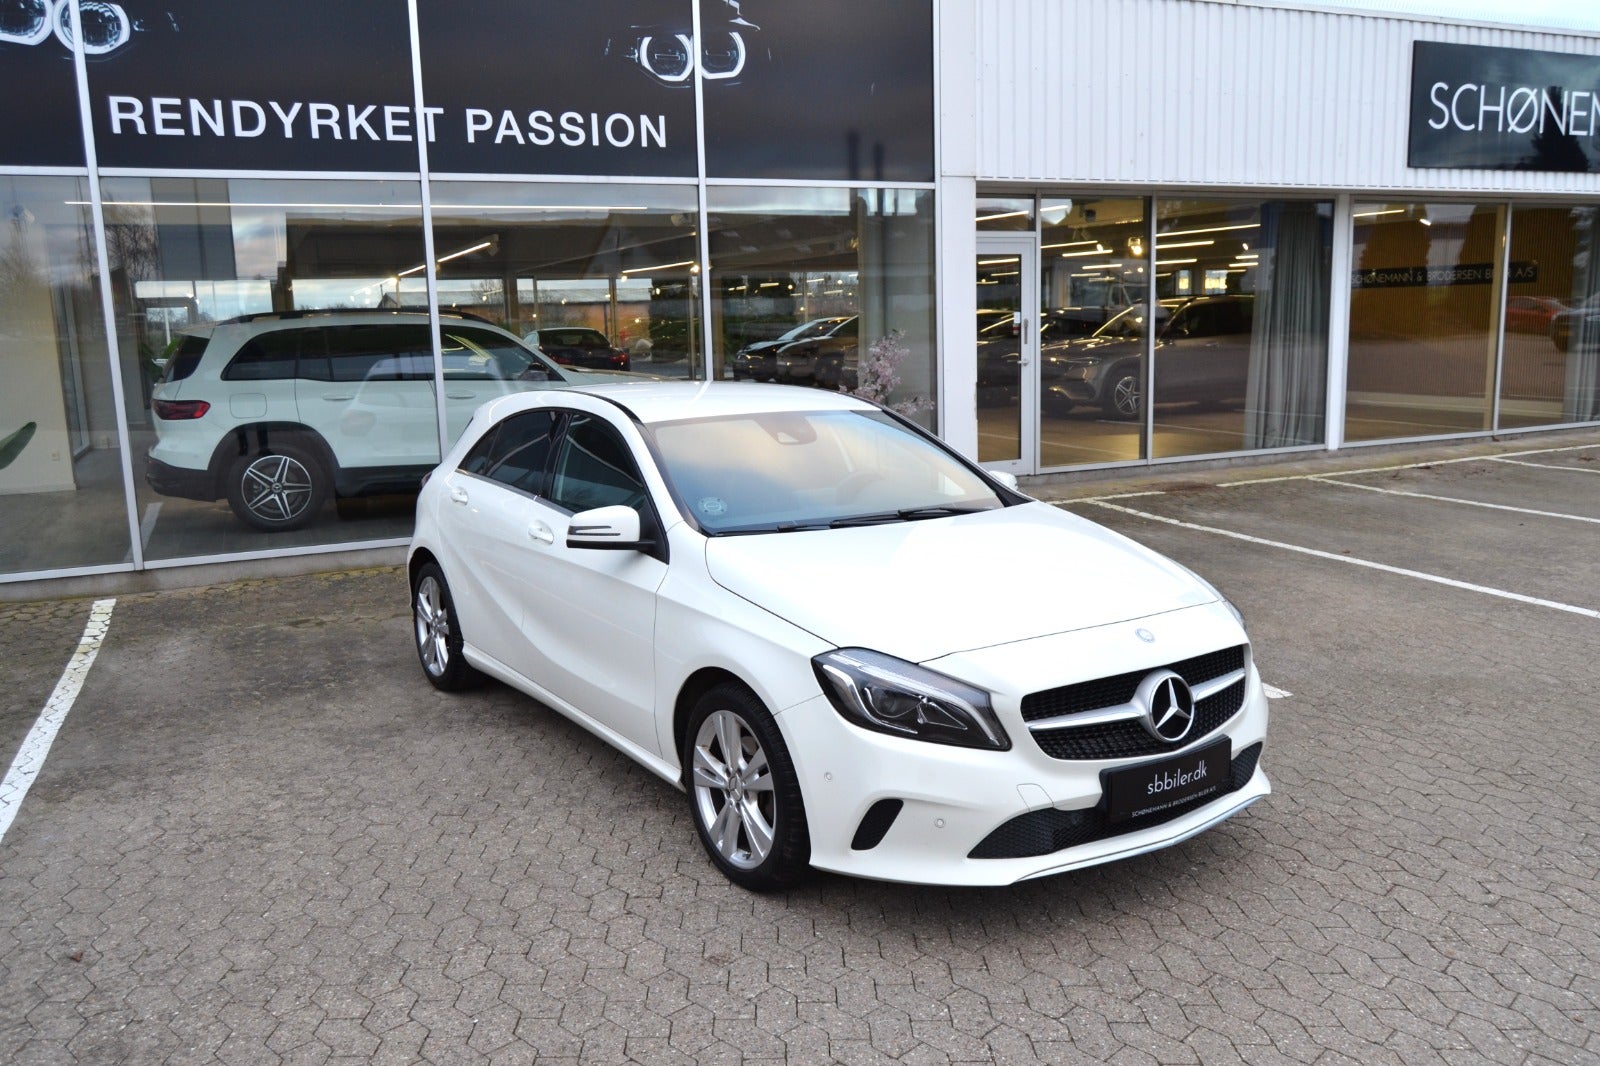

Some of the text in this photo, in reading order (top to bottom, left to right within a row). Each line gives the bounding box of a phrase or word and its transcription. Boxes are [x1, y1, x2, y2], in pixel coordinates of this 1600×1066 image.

[108, 95, 667, 148] RENDYRKET PASSION
[1147, 760, 1207, 795] sbbiler.dk
